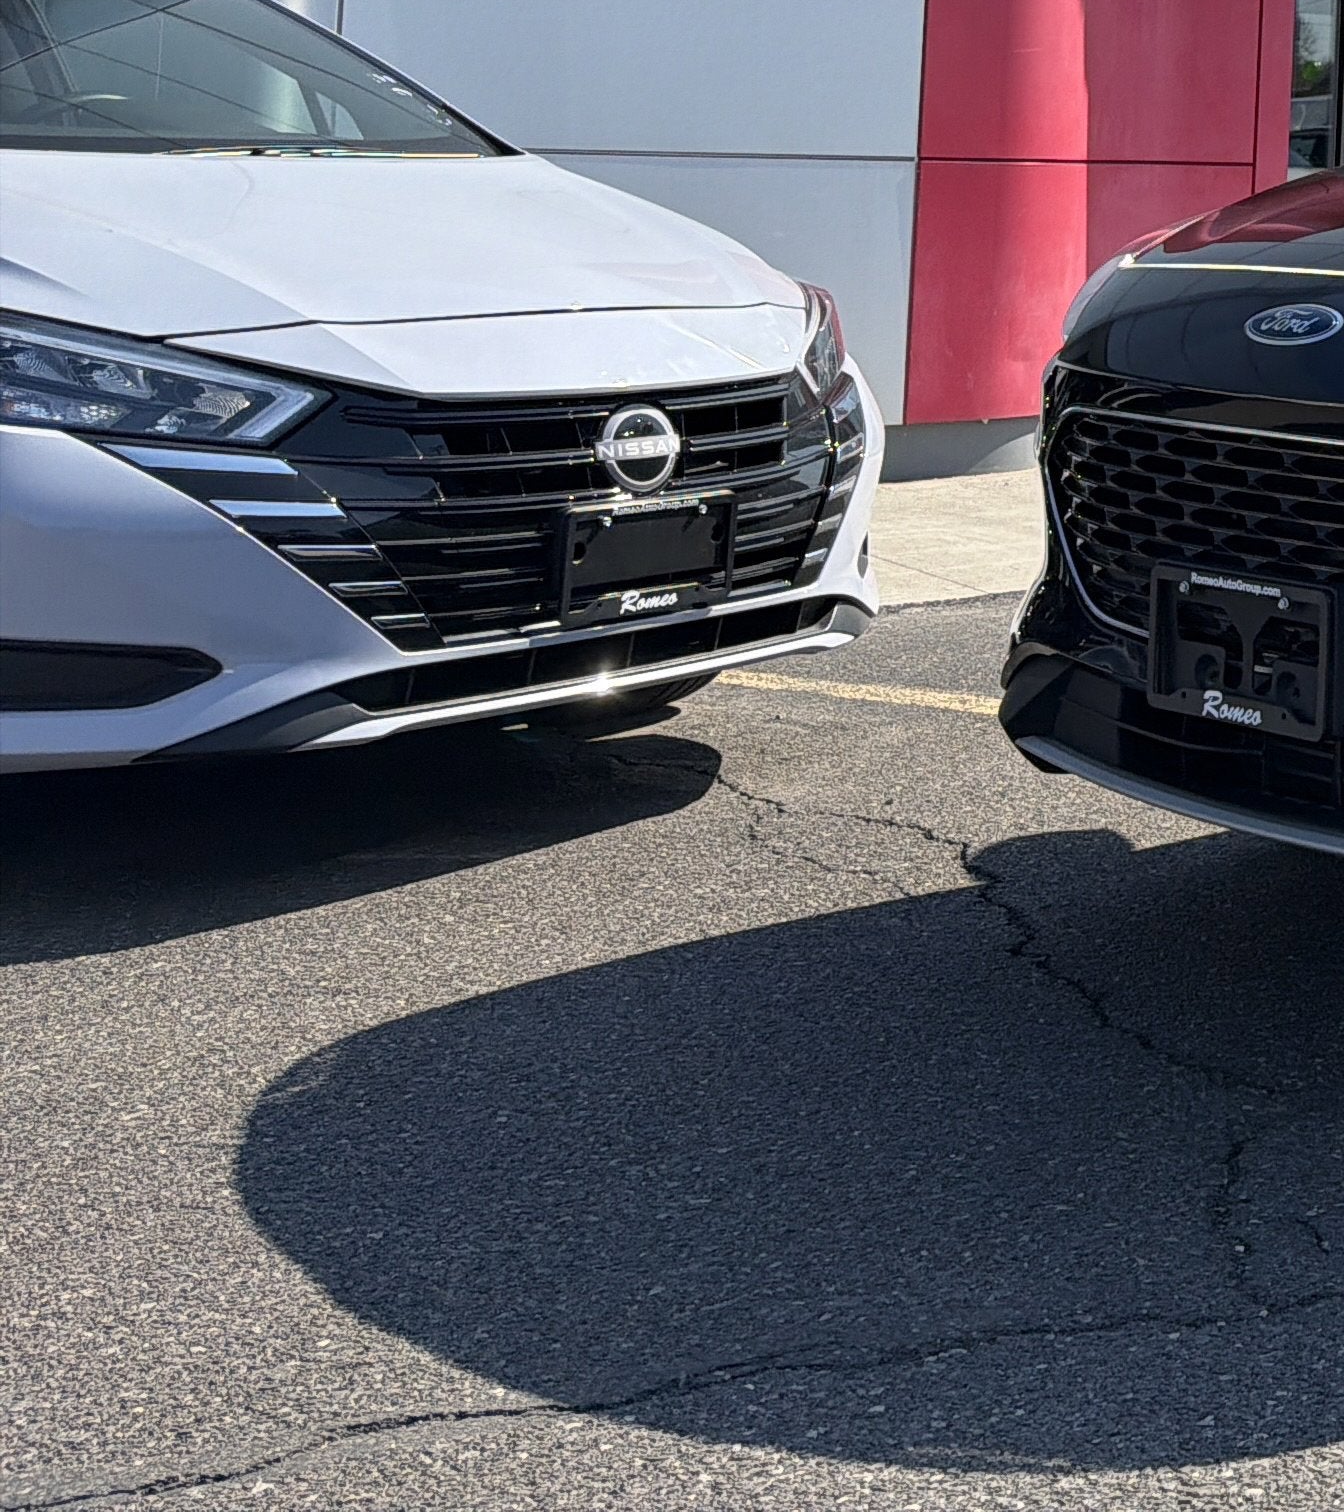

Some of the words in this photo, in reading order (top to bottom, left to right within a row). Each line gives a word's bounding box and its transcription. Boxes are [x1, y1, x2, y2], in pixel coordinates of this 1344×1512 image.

[1260, 309, 1320, 333] Ford
[599, 437, 679, 458] NISSAN
[1191, 572, 1281, 597] RomeoAutoGroup.com
[619, 590, 678, 614] Romeo
[1202, 690, 1262, 726] Romeo
